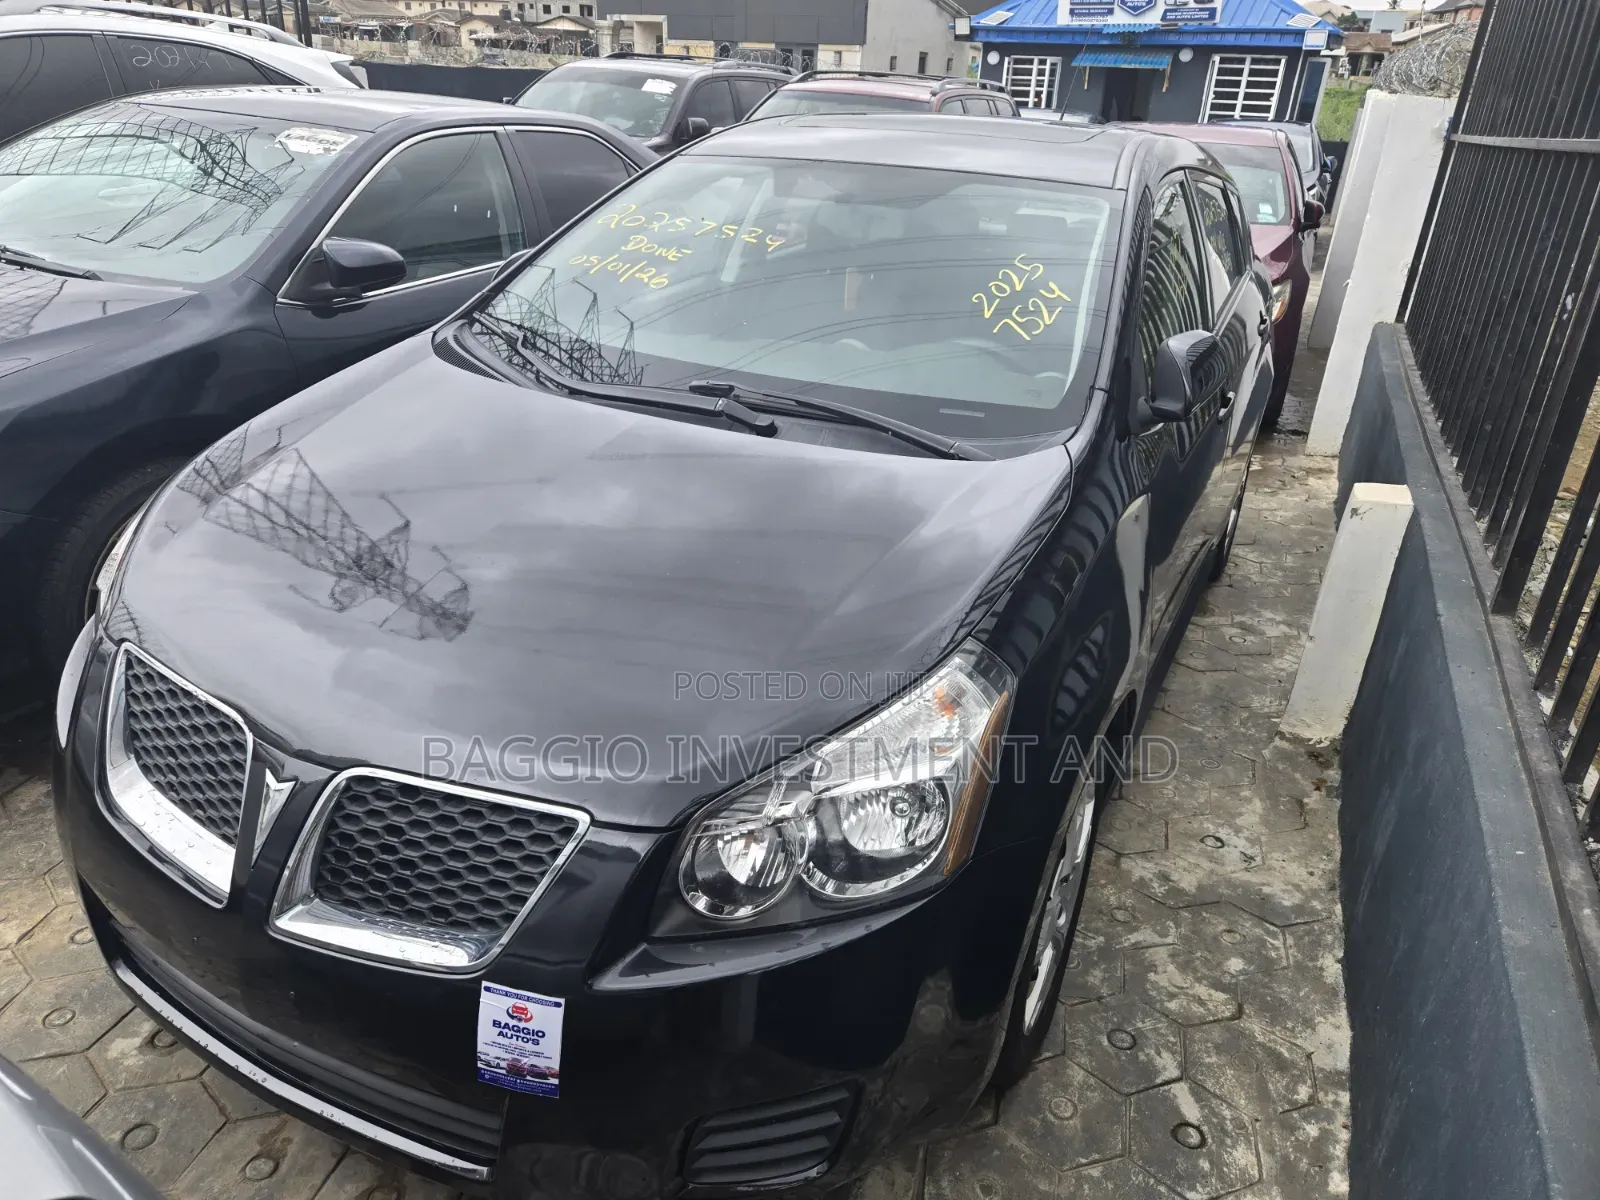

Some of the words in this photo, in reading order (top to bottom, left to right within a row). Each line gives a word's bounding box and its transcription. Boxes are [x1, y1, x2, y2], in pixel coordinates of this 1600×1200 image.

[621, 235, 693, 261] DONE
[568, 254, 669, 289] 05/01/26
[972, 253, 1044, 319] 2025
[993, 281, 1072, 341] 7524
[490, 987, 507, 996] THANK
[492, 1019, 546, 1039] BAGGIO
[496, 1030, 540, 1046] AUTO'S
